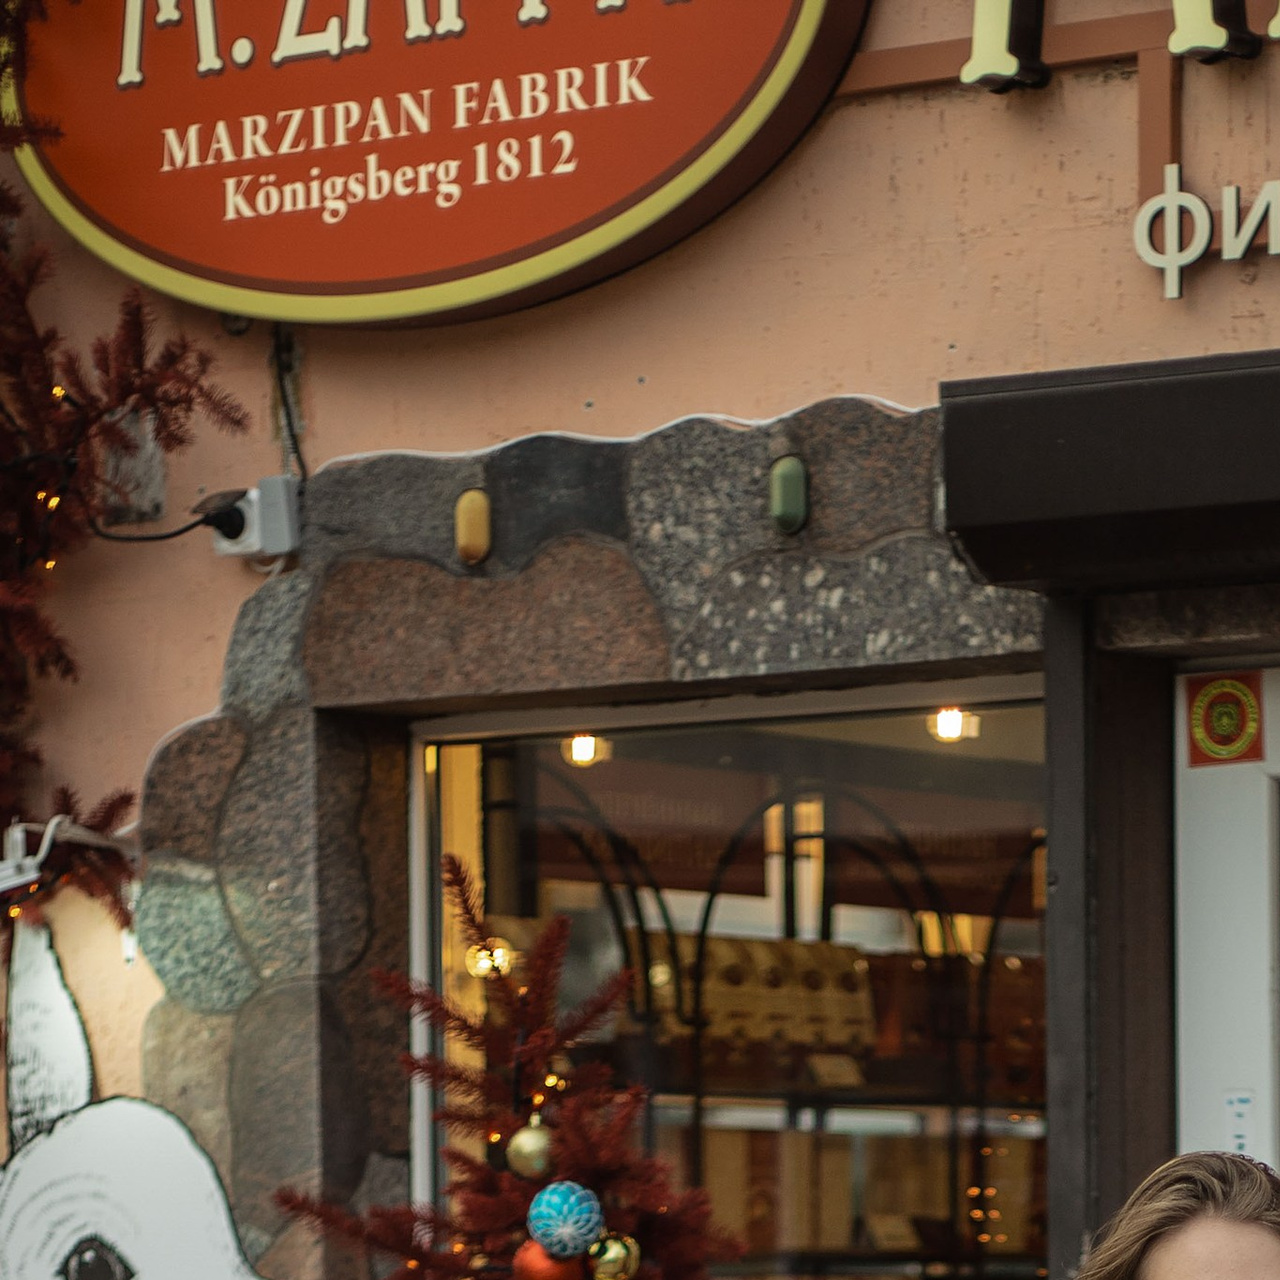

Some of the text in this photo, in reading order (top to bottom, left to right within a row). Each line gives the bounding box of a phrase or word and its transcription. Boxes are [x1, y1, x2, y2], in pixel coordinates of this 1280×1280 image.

[160, 56, 654, 172] MARZIPAN FABRIK
[222, 130, 579, 224] Königsberg 1812
